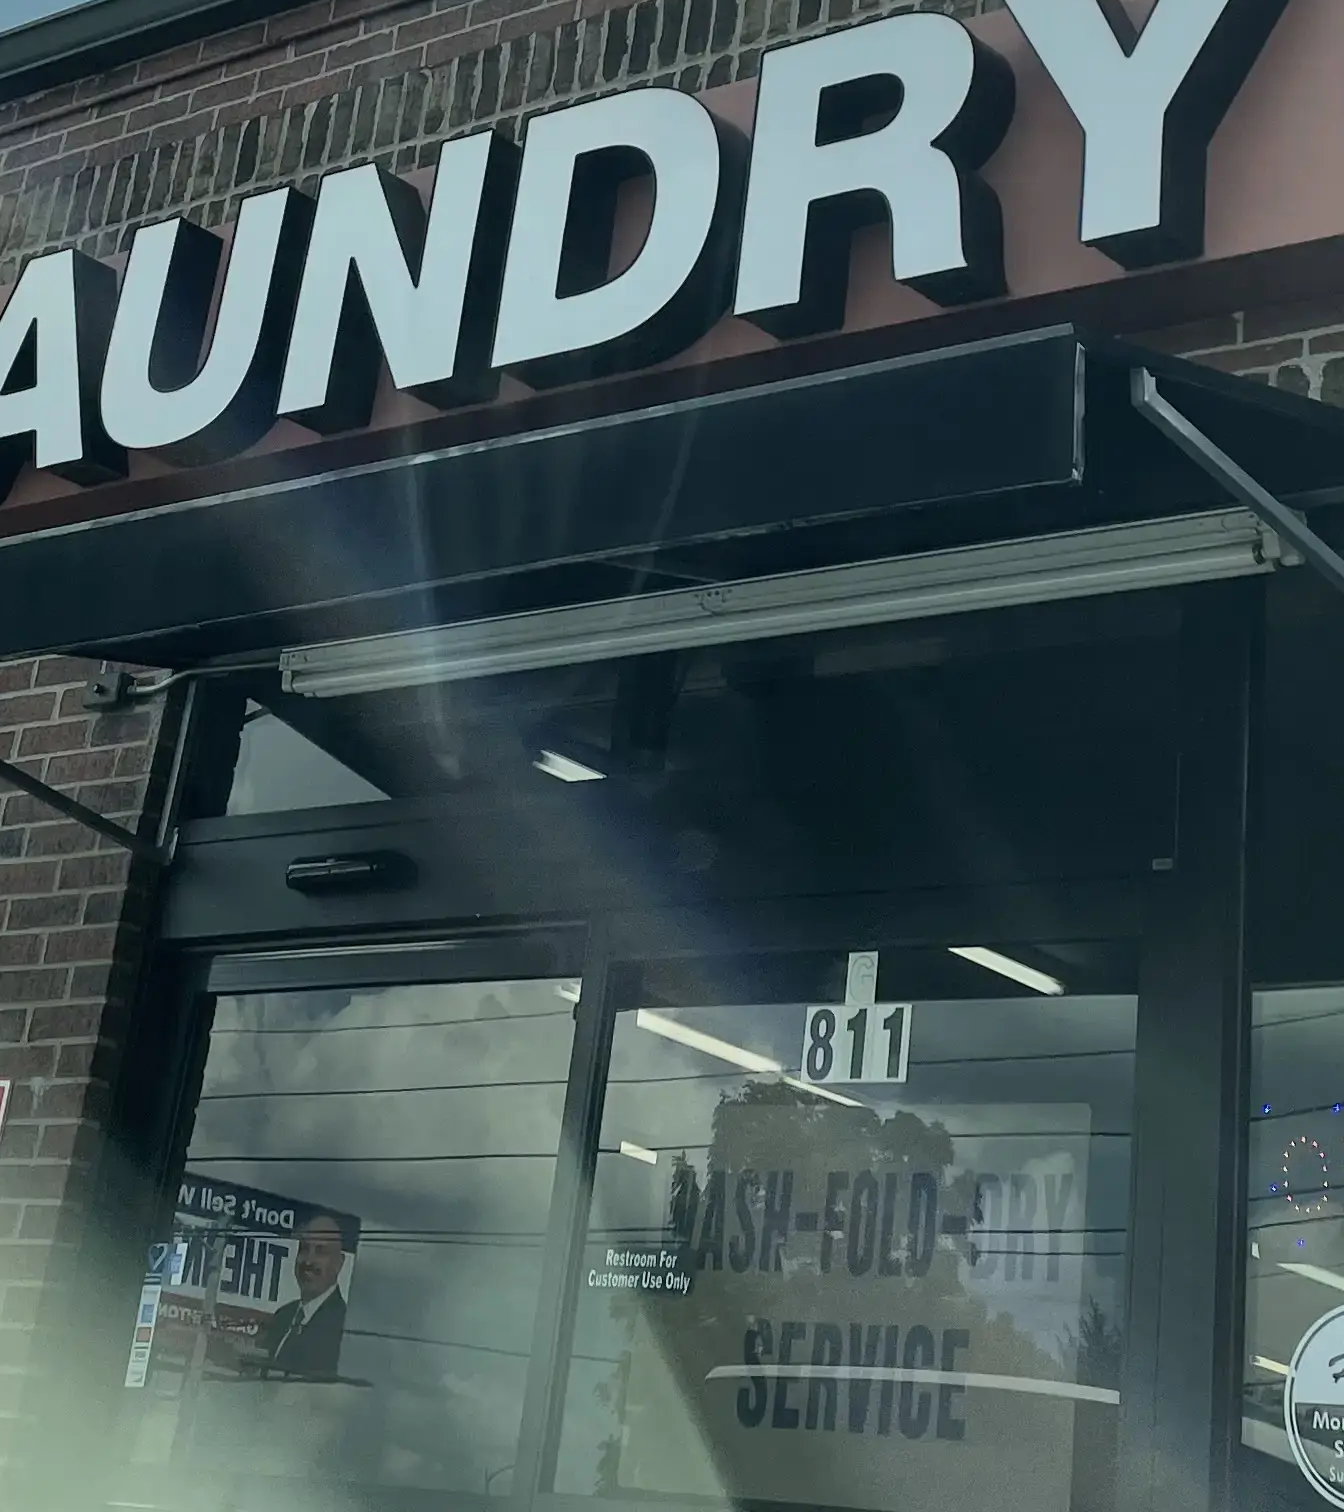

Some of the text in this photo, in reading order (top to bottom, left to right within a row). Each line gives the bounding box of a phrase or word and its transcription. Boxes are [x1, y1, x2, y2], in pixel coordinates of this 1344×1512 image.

[806, 1007, 903, 1081] 811
[588, 1269, 691, 1295] Customer Use Only
[605, 1249, 677, 1268] Restroom For
[737, 1319, 971, 1441] SERVICE
